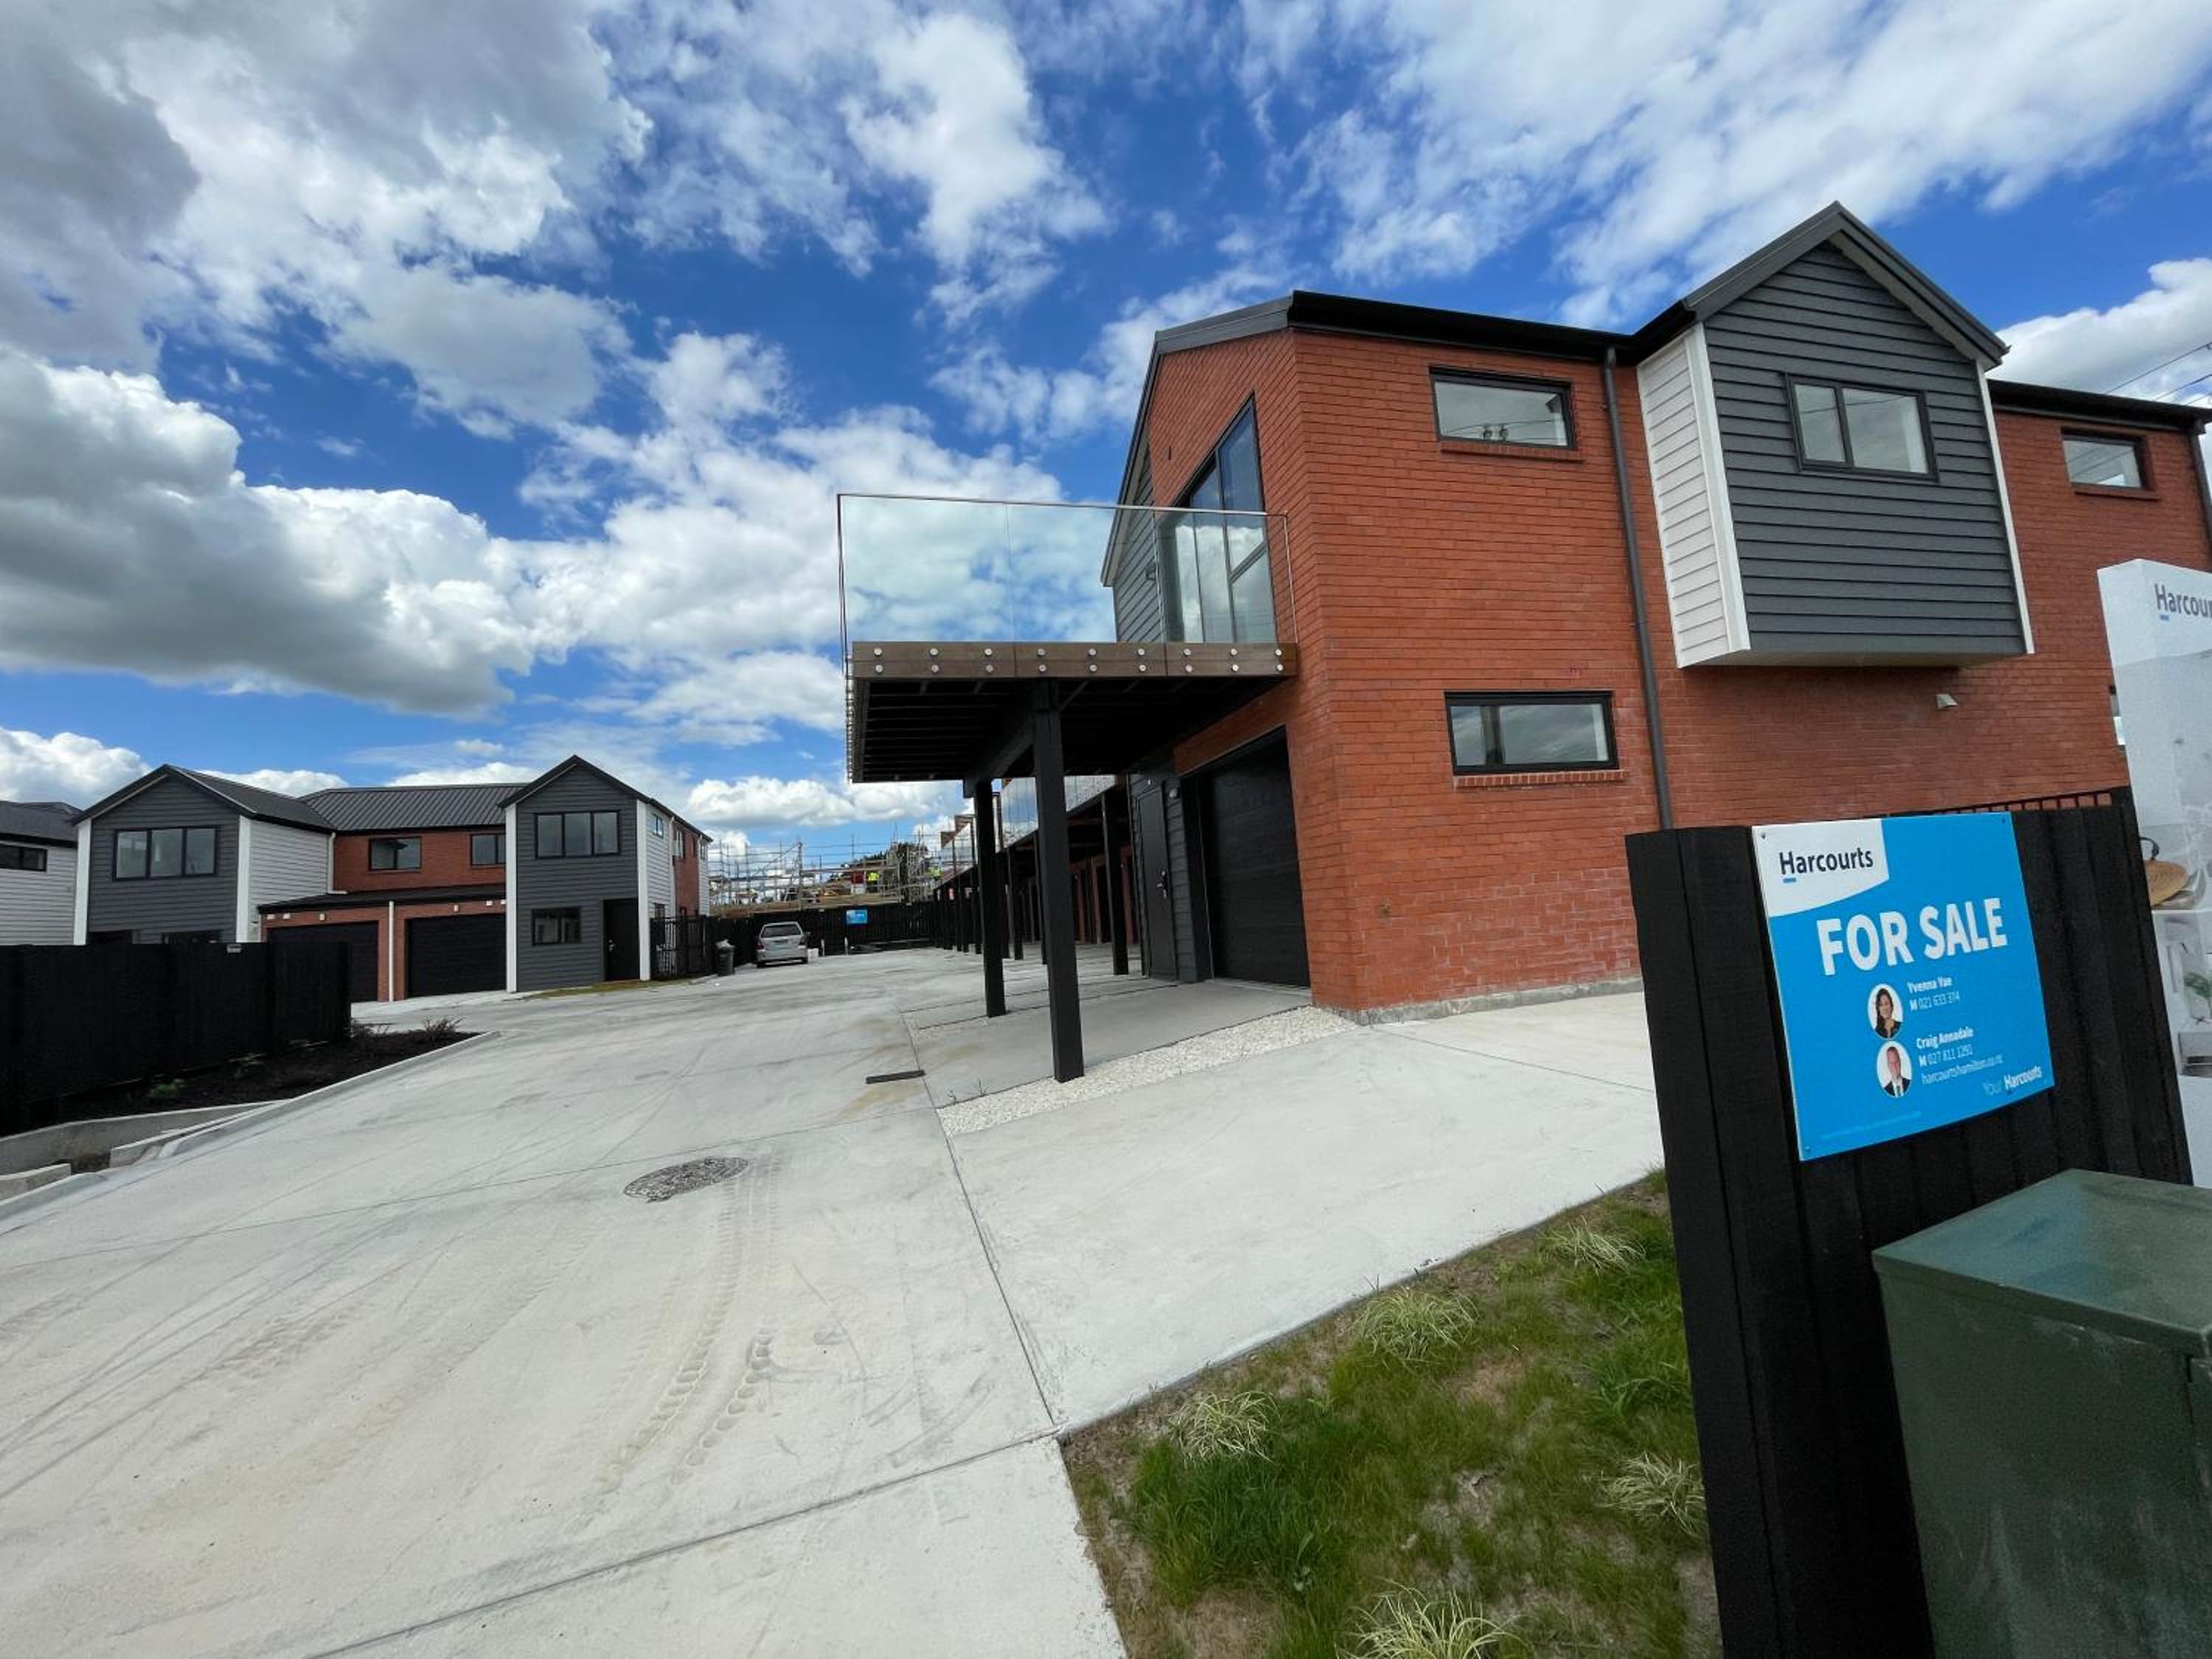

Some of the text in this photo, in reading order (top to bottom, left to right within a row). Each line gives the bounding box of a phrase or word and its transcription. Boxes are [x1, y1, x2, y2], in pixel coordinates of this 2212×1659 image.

[1779, 847, 1874, 874] Harcourts
[1816, 897, 2008, 975] FOR SALE
[1910, 999, 1917, 1011] M
[1919, 996, 1932, 1009] 021
[1916, 1034, 1938, 1049] Craig
[1918, 1055, 1927, 1068] M
[1927, 1051, 1941, 1065] 027
[2003, 1065, 2042, 1091] Harcourts
